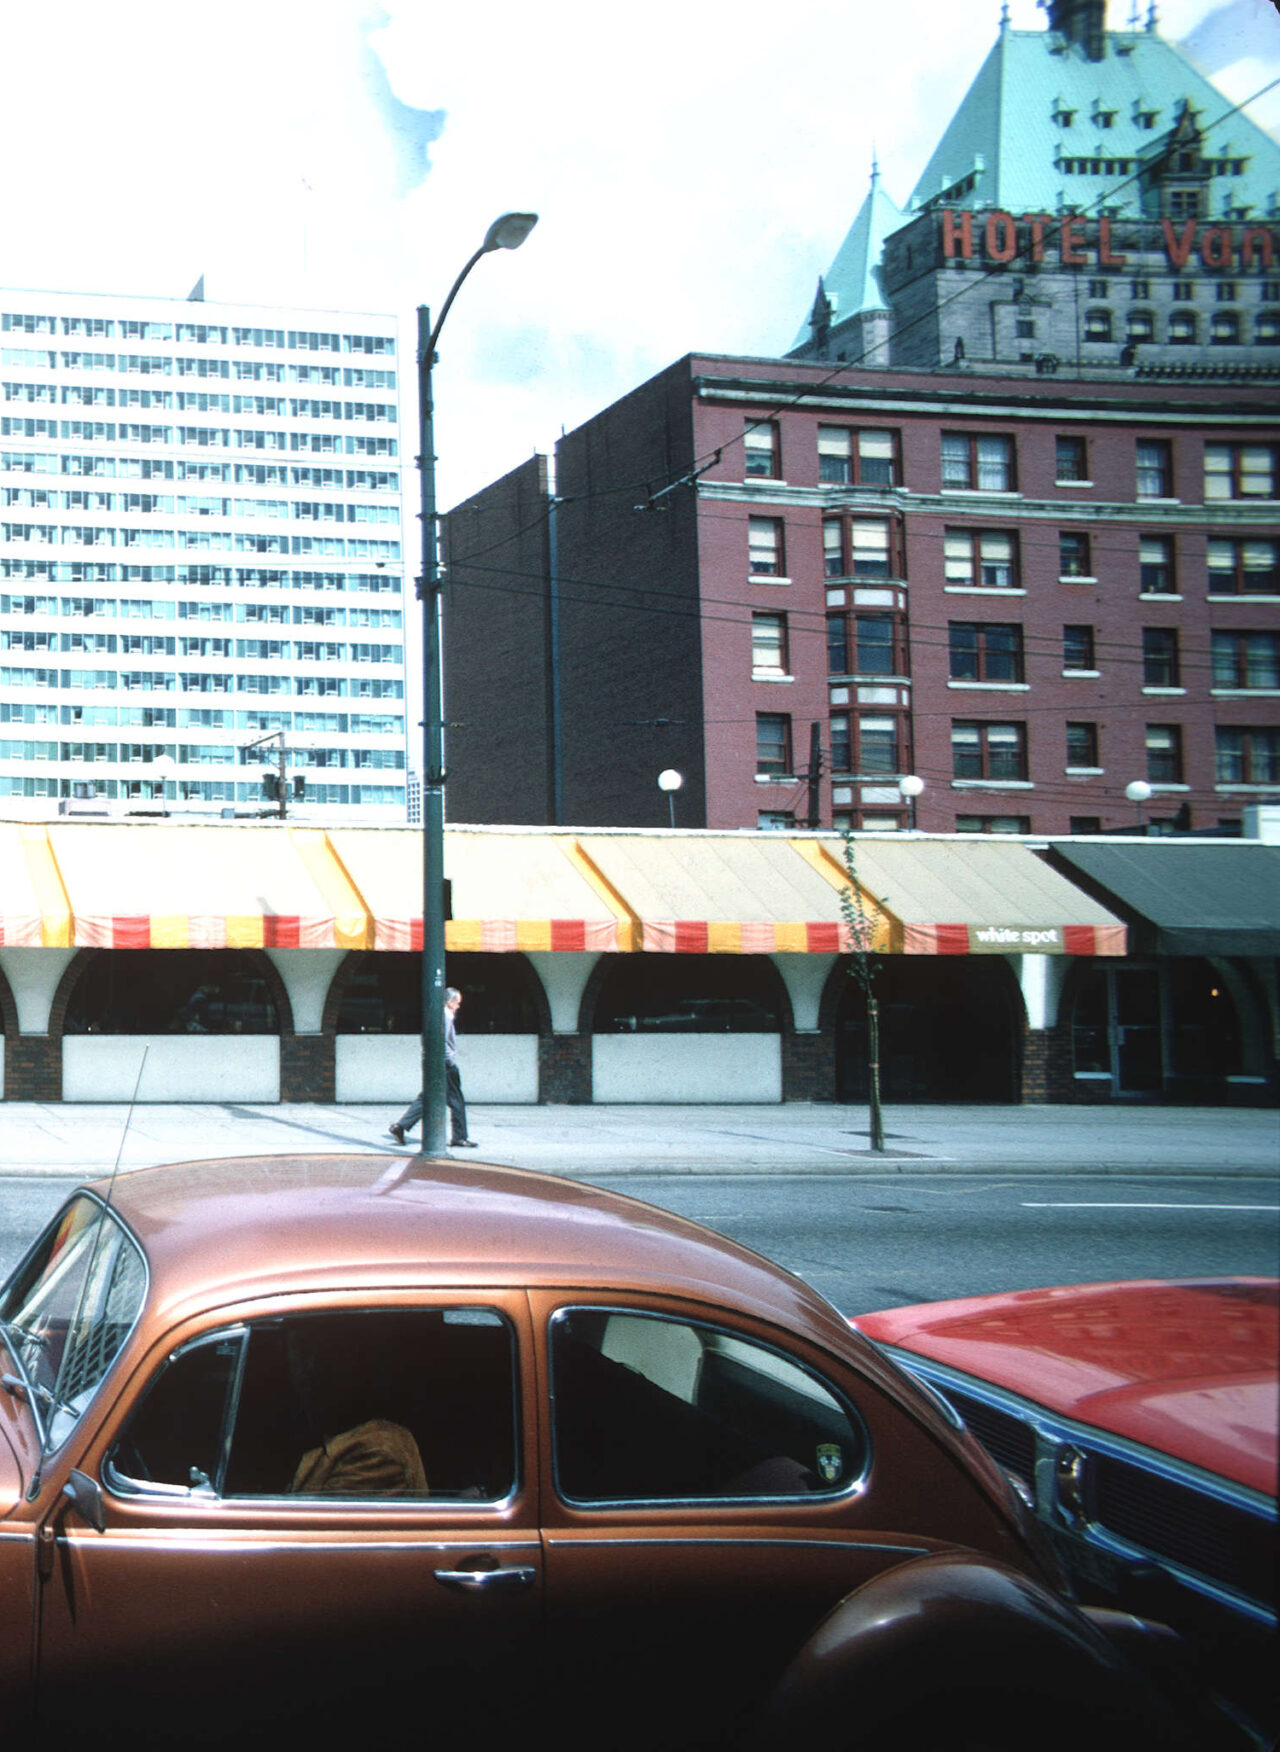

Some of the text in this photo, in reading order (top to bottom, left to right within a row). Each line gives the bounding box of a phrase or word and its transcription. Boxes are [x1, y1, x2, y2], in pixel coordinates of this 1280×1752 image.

[943, 209, 1273, 267] HOTEL Van
[976, 926, 1058, 946] white spot
